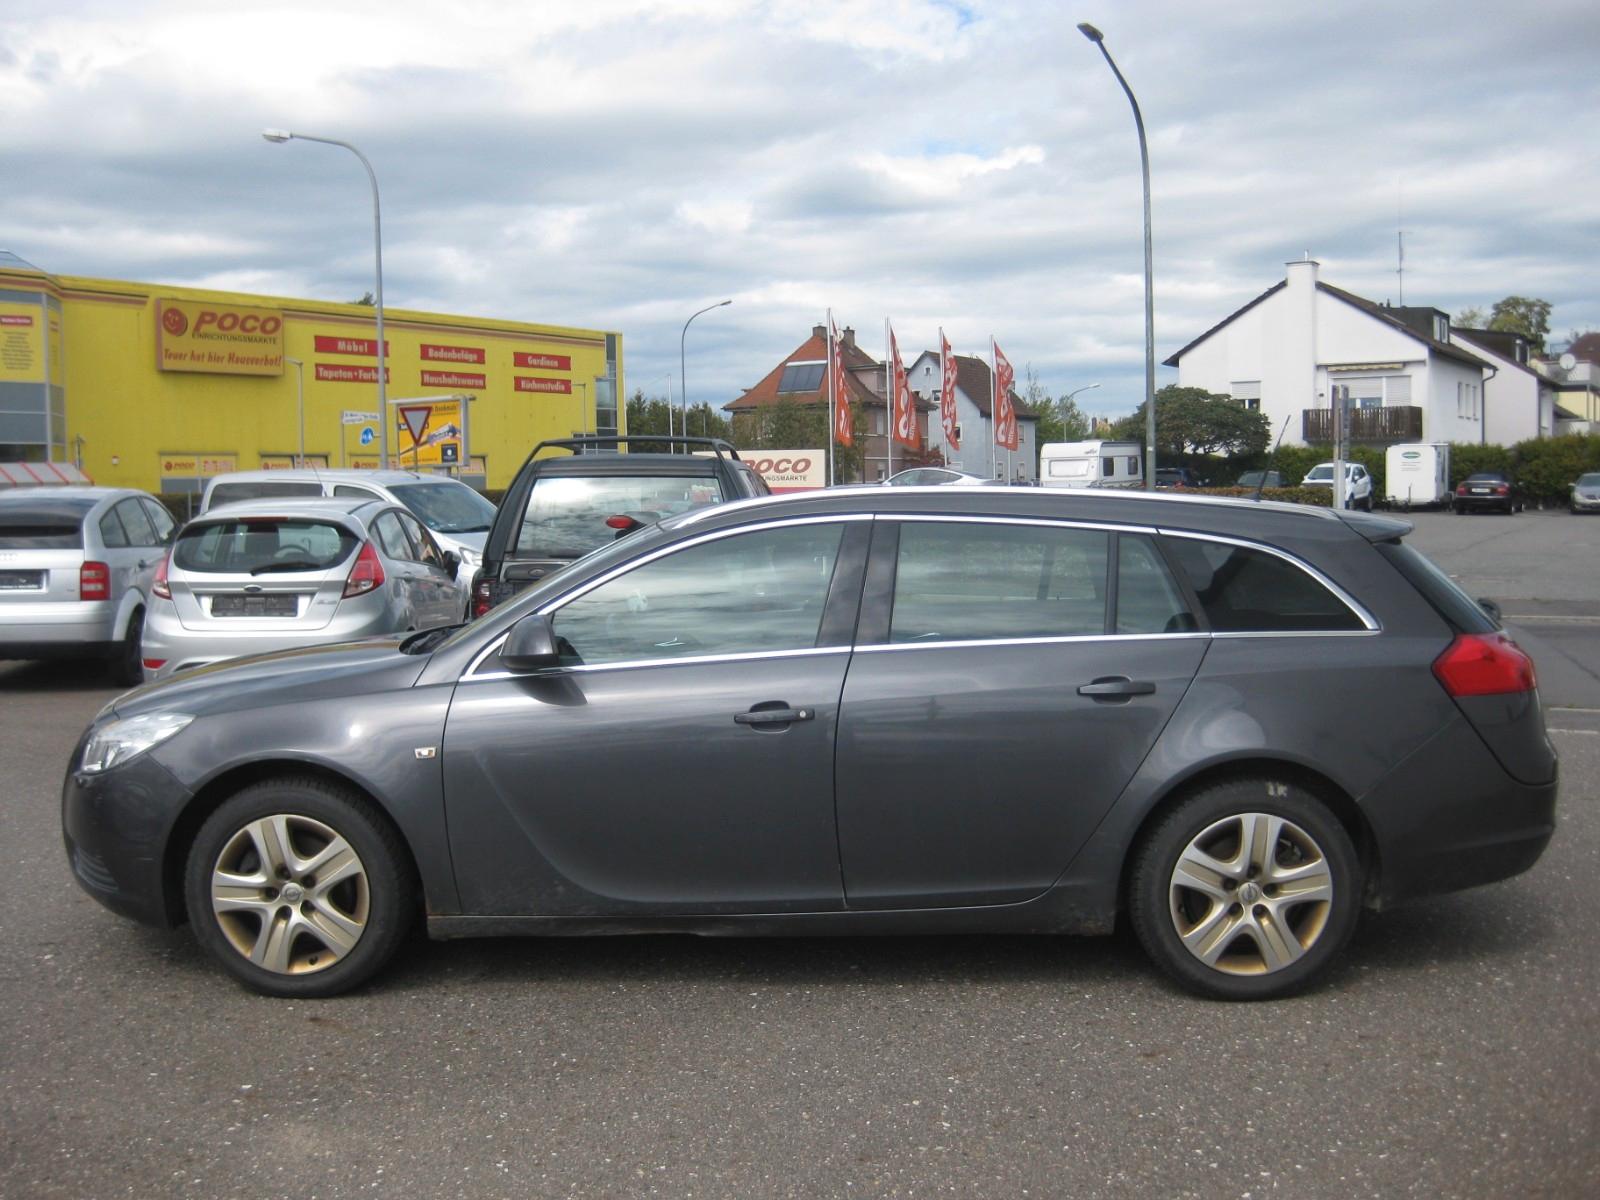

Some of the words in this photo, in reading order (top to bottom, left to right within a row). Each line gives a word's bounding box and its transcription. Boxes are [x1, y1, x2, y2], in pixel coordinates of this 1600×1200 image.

[193, 312, 281, 335] POCO
[337, 340, 368, 352] Möbel
[164, 348, 188, 360] Teuer
[208, 352, 225, 364] hier
[527, 355, 559, 368] Gardinen
[318, 366, 352, 379] Tapeten
